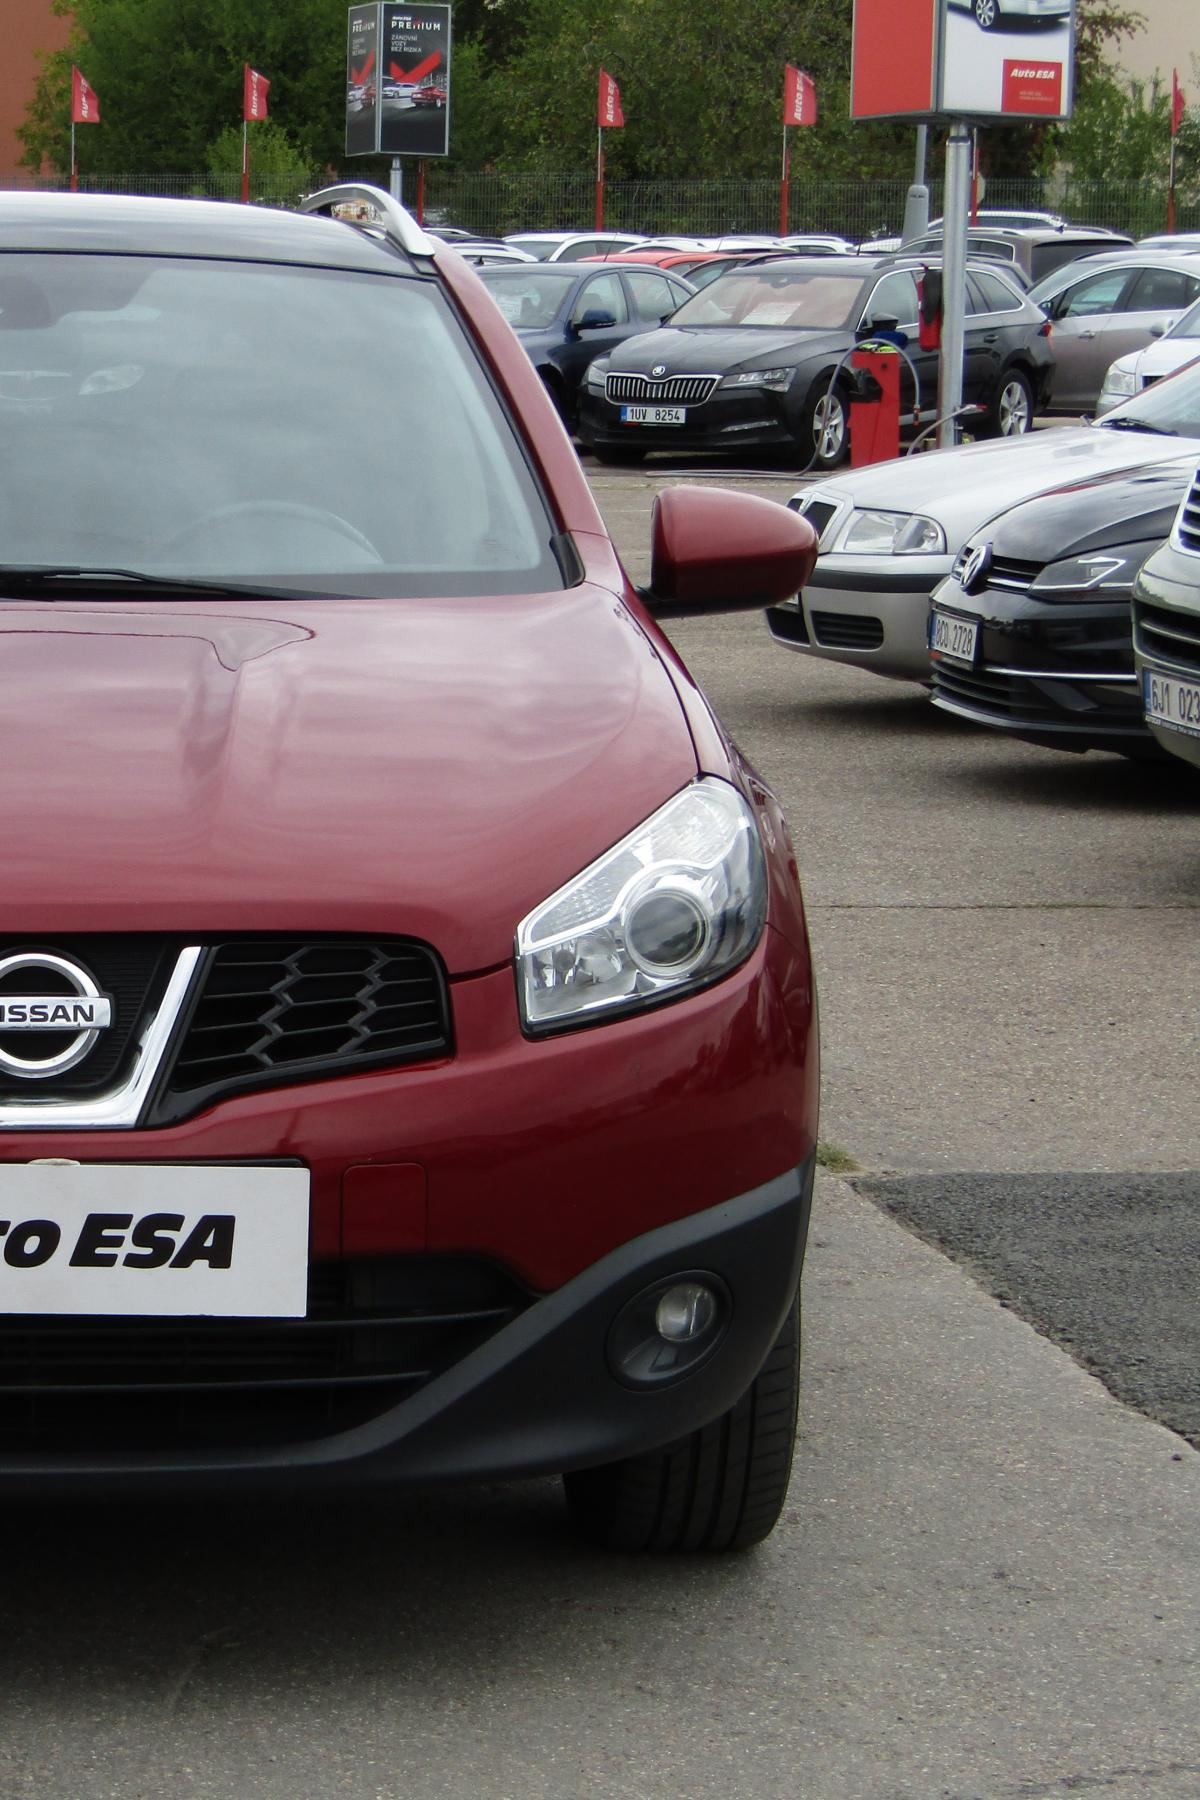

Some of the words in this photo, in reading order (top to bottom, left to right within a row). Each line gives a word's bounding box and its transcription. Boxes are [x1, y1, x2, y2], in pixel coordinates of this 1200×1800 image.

[1010, 68, 1035, 79] Auto
[1035, 69, 1056, 80] ESA
[793, 92, 803, 121] Auto
[630, 408, 647, 420] 1UV
[655, 409, 680, 422] 8254
[952, 624, 973, 656] 2728
[1151, 678, 1170, 716] 6J1
[68, 1212, 236, 1270] ESA
